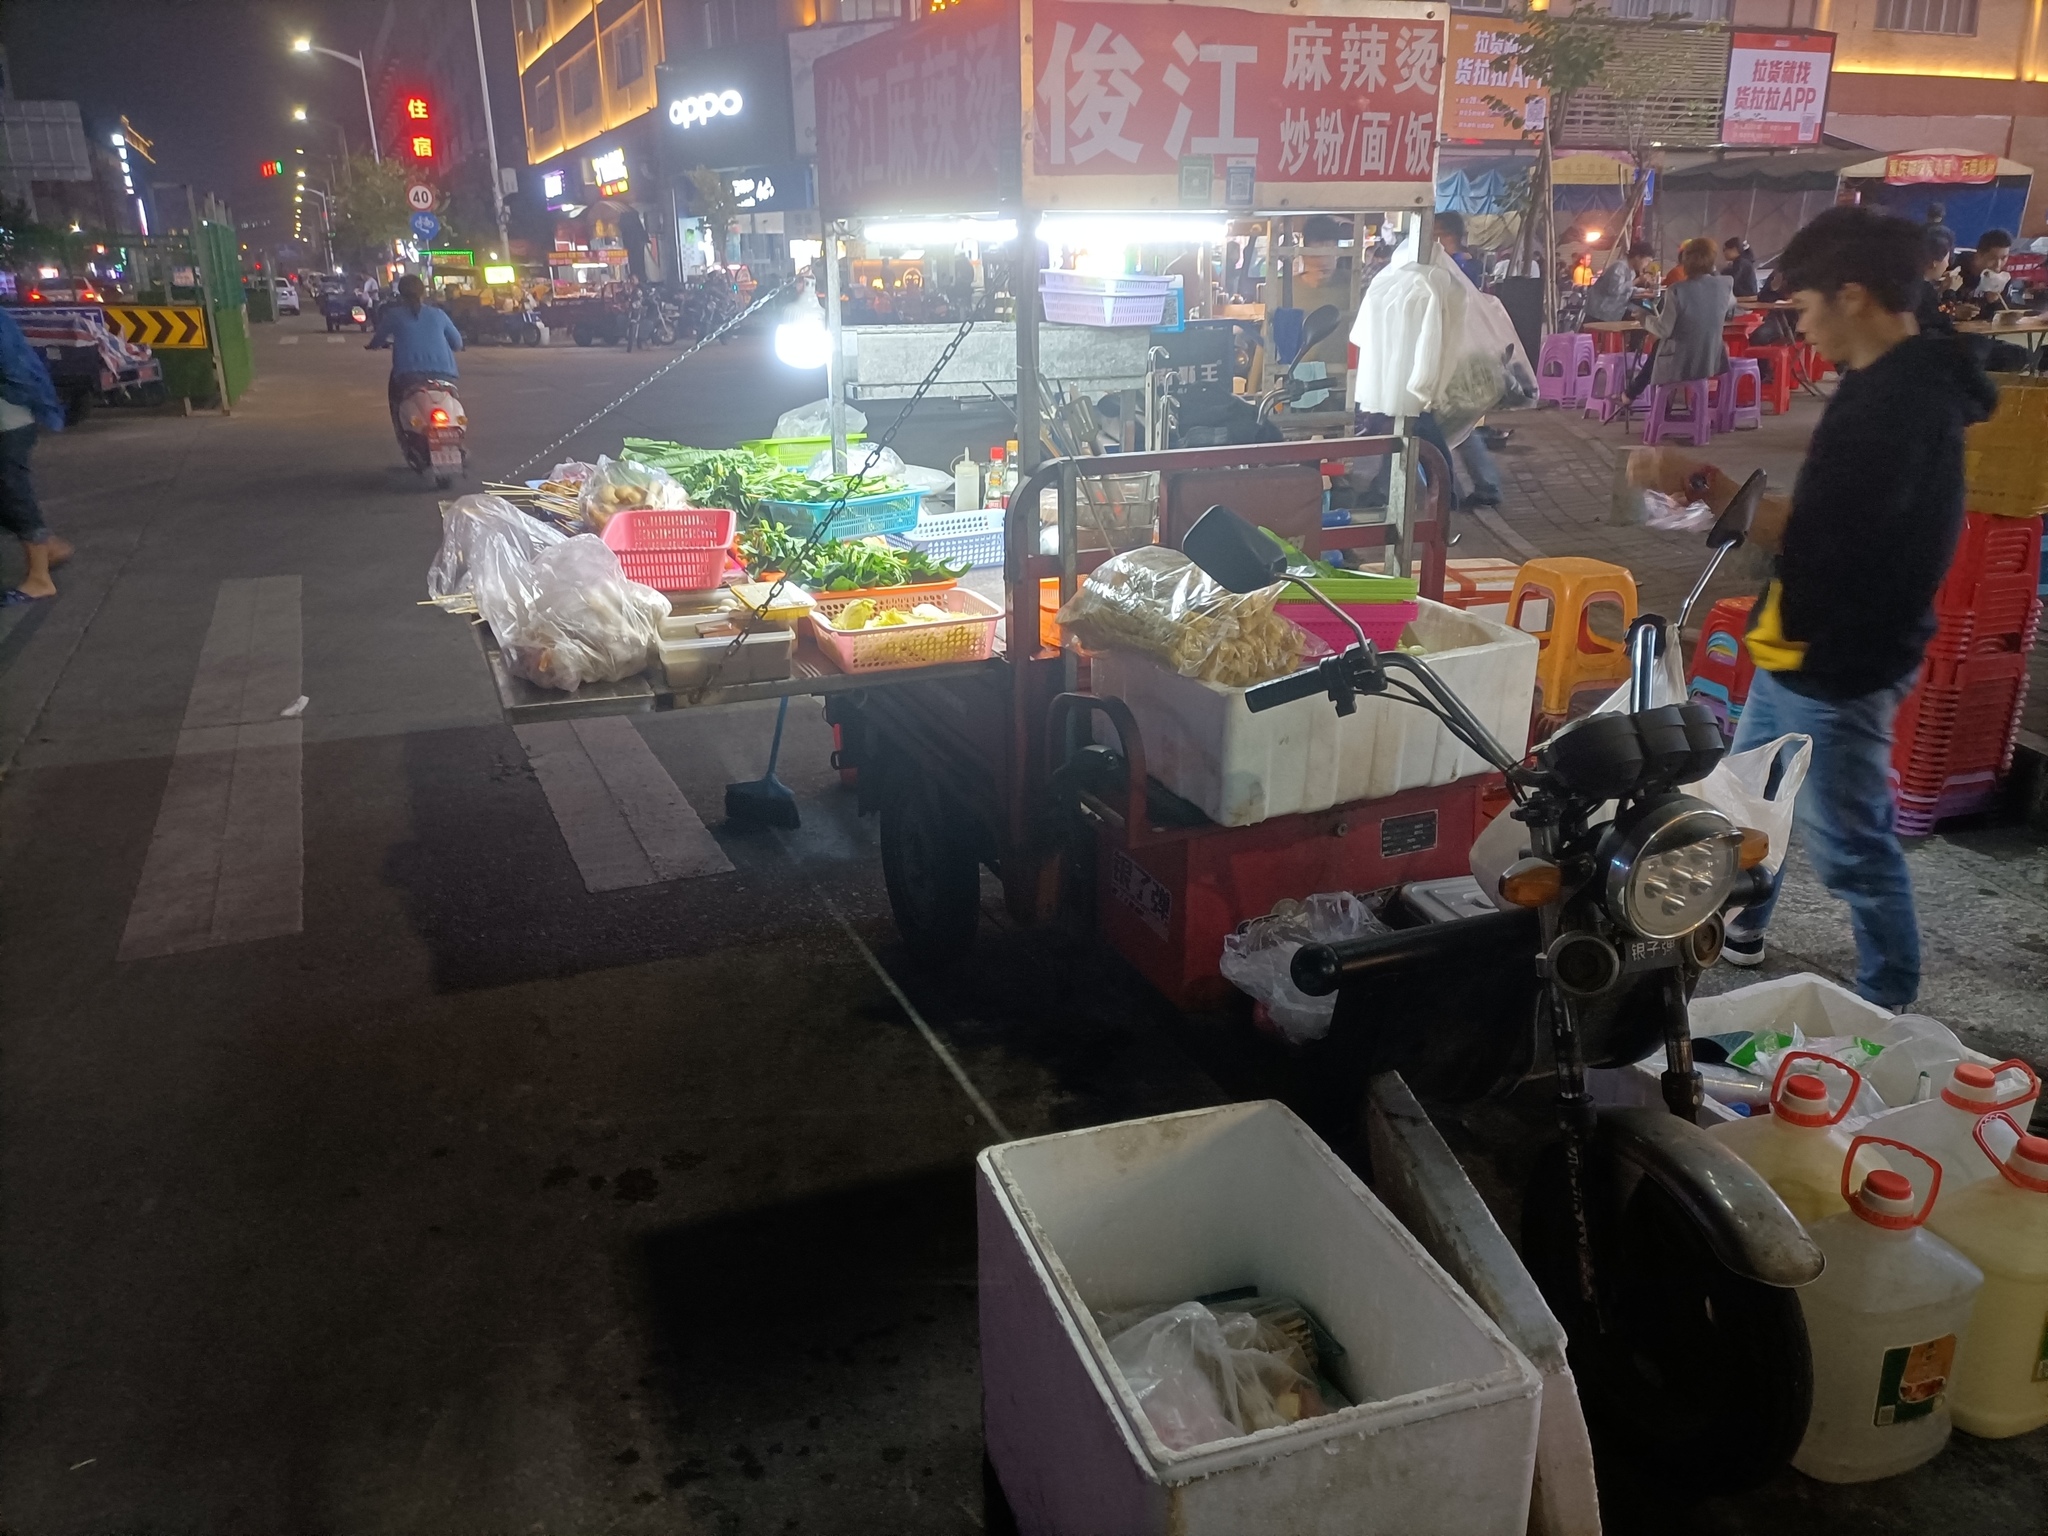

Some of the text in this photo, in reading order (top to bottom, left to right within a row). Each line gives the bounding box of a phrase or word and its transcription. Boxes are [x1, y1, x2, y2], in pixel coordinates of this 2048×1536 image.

[1282, 20, 1440, 95] 麻辣烫
[1752, 59, 1812, 84] 拉货就找
[669, 89, 743, 129] oppo
[1036, 20, 1259, 165] 俊江
[1734, 86, 1817, 112] 货拉拉APP
[408, 98, 433, 157] 住宿
[1277, 107, 1434, 176] 炒粉/面/饭
[412, 190, 429, 204] 40
[1631, 938, 1676, 962] 银子弹
